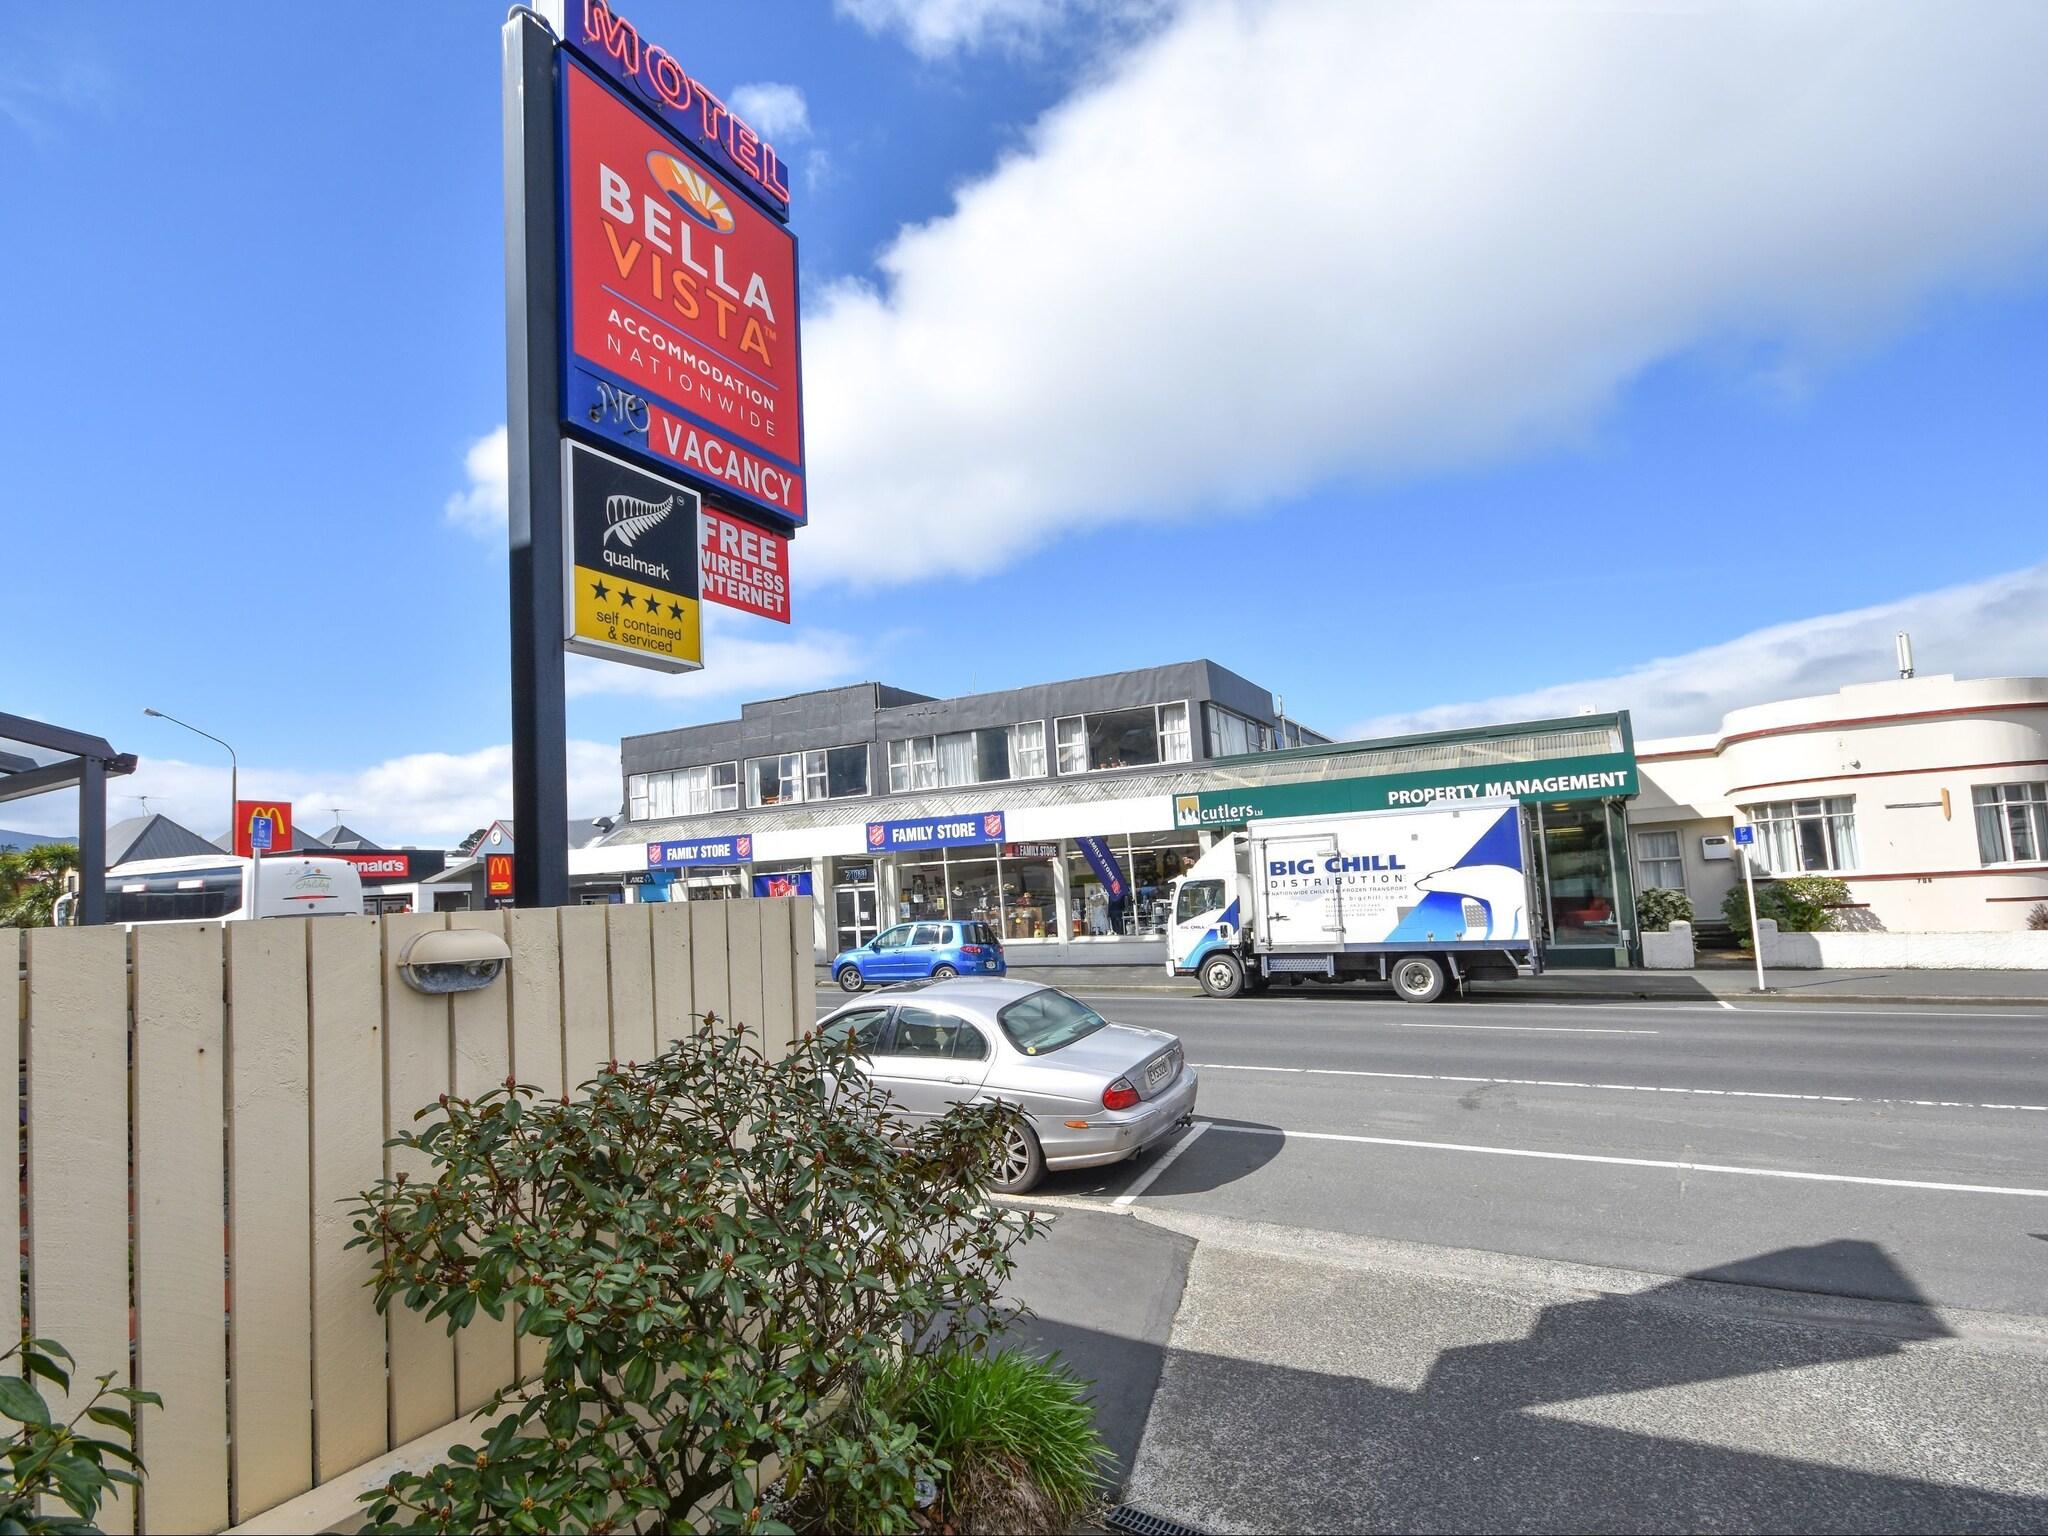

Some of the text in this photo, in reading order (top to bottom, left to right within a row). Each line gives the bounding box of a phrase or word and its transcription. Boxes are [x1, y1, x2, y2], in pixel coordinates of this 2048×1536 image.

[584, 0, 790, 204] MOTEL
[599, 162, 775, 324] BELLA
[601, 219, 772, 368] VISTA
[608, 308, 775, 413] ACCOMMODATION
[607, 333, 776, 438] NATIONWIDE
[596, 382, 651, 433] NO
[662, 416, 792, 506] VACANCY
[701, 513, 777, 571] FREE
[603, 549, 670, 581] qualmark
[701, 570, 785, 613] NTERNET
[596, 611, 682, 641] self contained
[608, 625, 673, 653] & serviced
[1387, 771, 1628, 806] PROPERTY MANAGEMENT
[258, 819, 266, 829] P
[1201, 803, 1254, 821] cutlers
[892, 825, 934, 843] FAMILY
[937, 822, 976, 840] STORE
[1740, 827, 1746, 835] P
[357, 860, 404, 873] nald's
[666, 845, 699, 860] FAMILY
[700, 843, 731, 858] STORE
[1020, 845, 1057, 857] FAMILY STORE
[1086, 836, 1103, 858] AMILY
[1100, 859, 1116, 881] STORE
[1269, 854, 1406, 876] BIG CHILL
[1270, 874, 1403, 889] DISTRIBUTION
